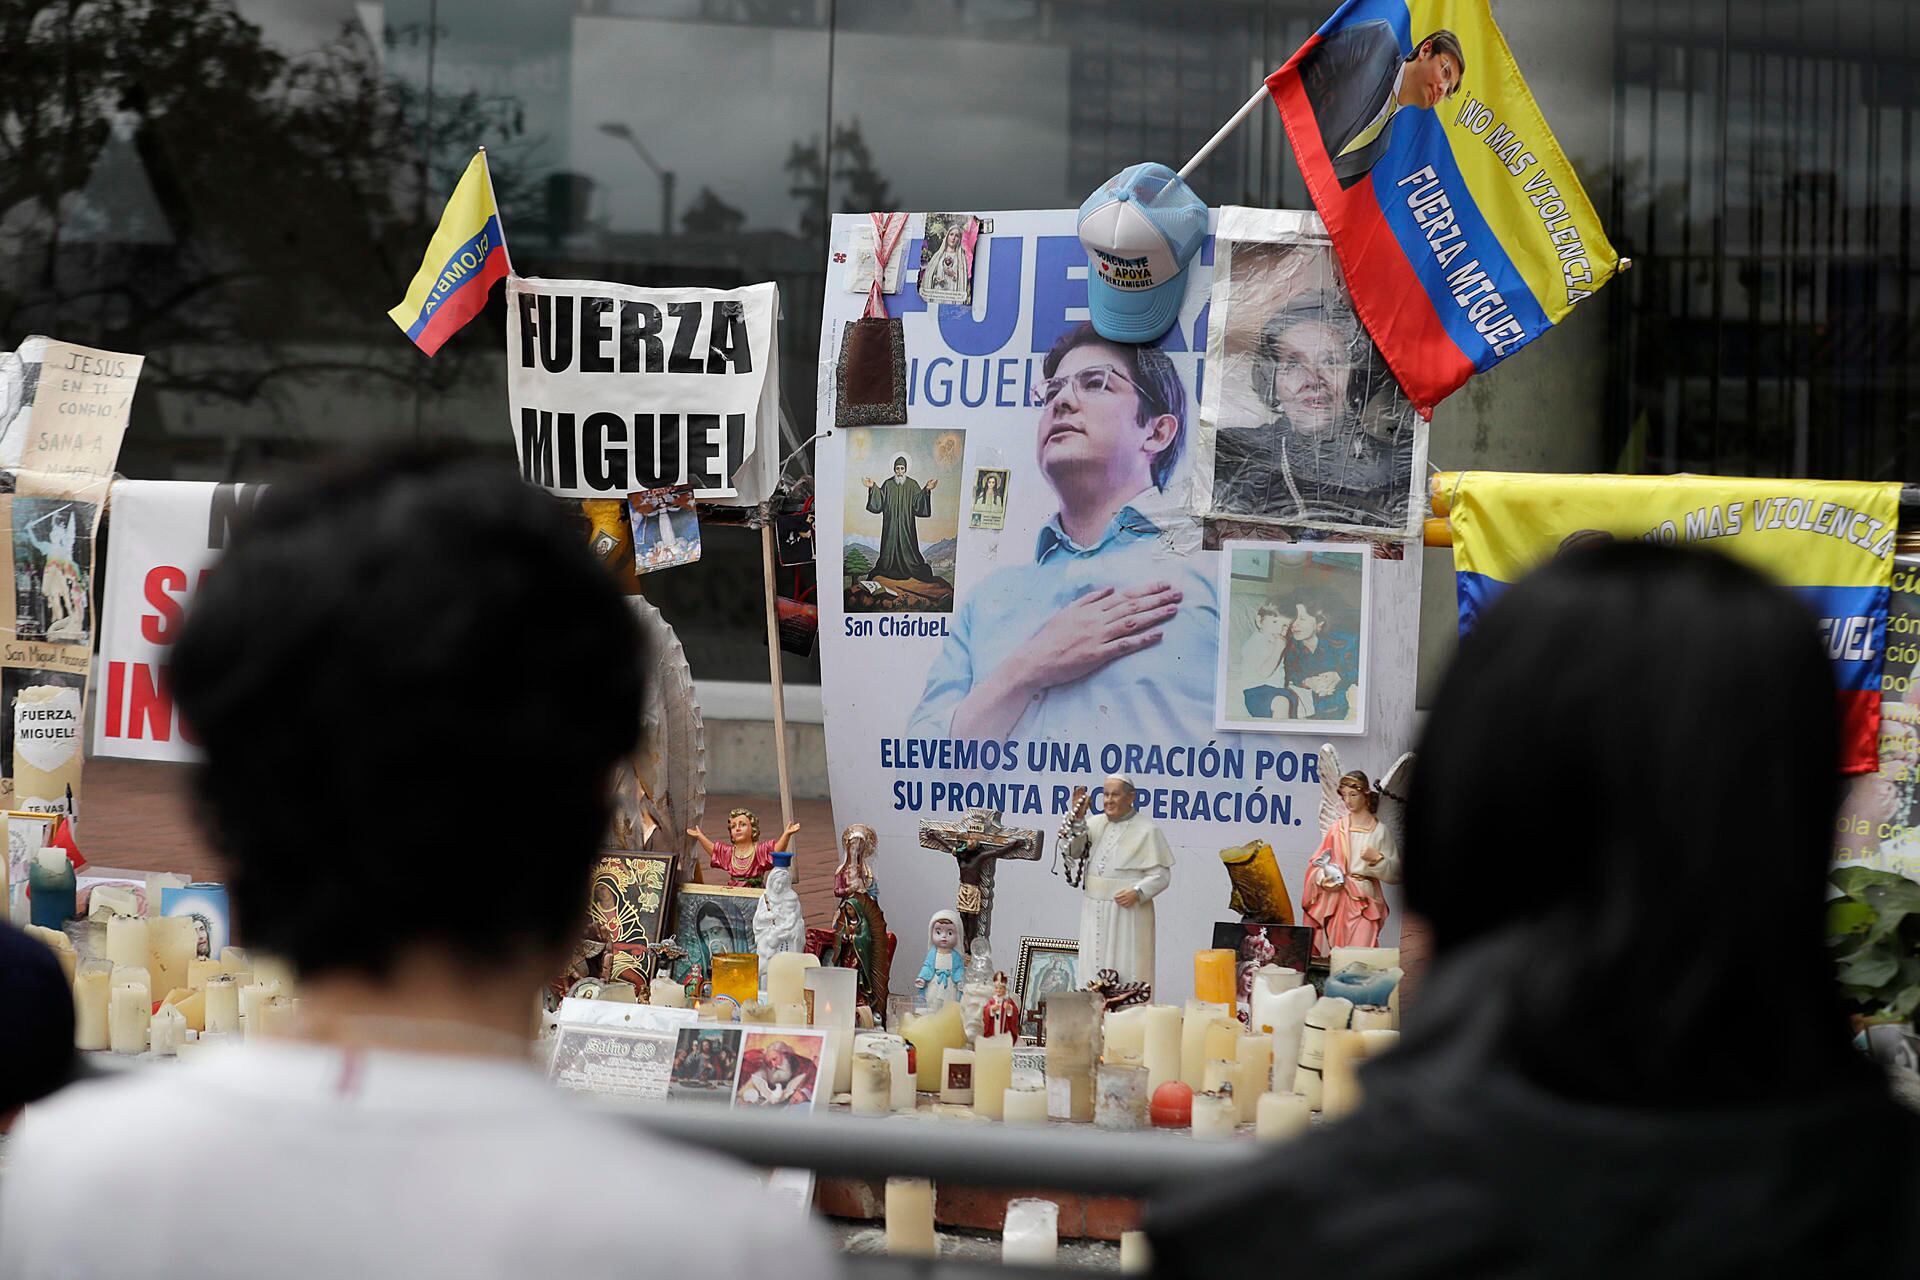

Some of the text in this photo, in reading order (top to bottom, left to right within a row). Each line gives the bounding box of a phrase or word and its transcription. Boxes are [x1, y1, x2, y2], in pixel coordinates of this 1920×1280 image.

[1484, 122, 1537, 177] MAS
[1522, 169, 1594, 306] VIOLENCIA
[1114, 268, 1152, 280] APOYA
[1135, 256, 1149, 268] TE
[1397, 163, 1527, 357] FUERZA MIGUEL
[519, 293, 753, 375] FUERZA
[65, 352, 125, 378] JESUS
[61, 379, 108, 395] EN TI
[908, 357, 1042, 408] IGUEL
[1684, 501, 1744, 544] MAS
[1753, 497, 1896, 560] VIOLENCIA
[844, 616, 873, 637] San
[20, 727, 75, 739] MIGUEL!
[880, 738, 1321, 783] ELEVEMOS UNA ORACIÓN POR
[44, 804, 65, 814] VAS
[893, 780, 923, 811] SU
[931, 781, 1043, 815] PRONTA
